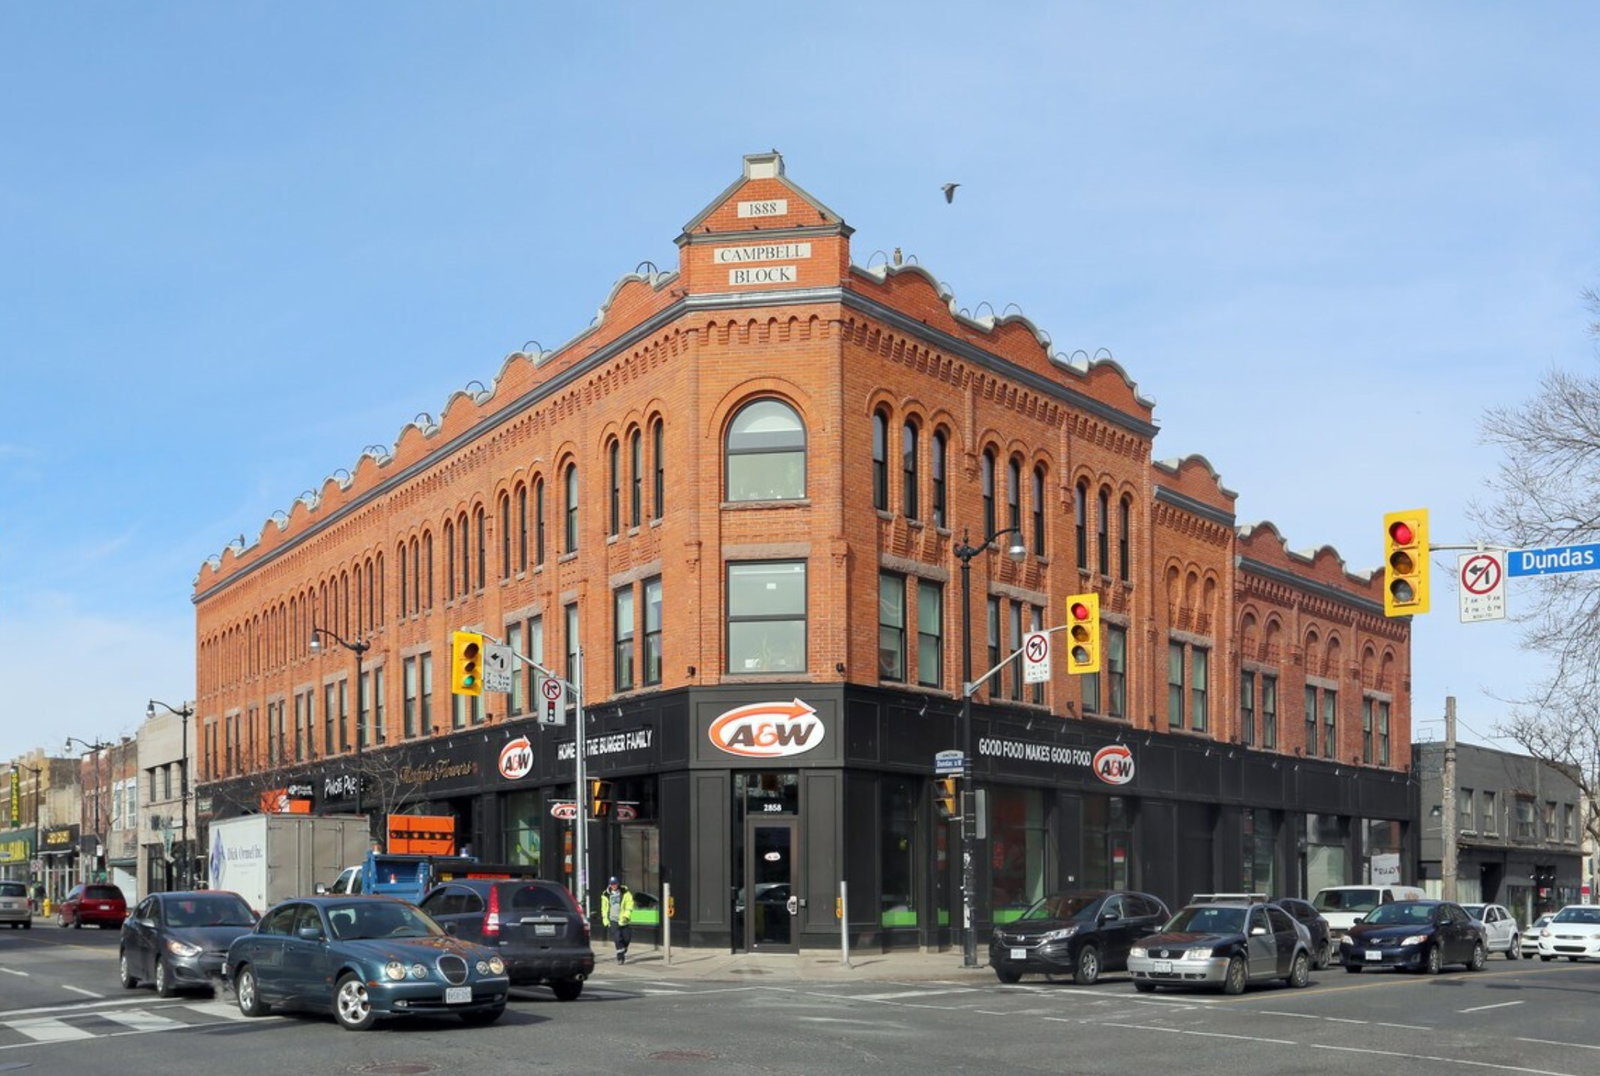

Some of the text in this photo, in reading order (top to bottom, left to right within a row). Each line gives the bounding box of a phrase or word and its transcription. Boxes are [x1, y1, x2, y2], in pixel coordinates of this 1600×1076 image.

[749, 202, 777, 216] 1888
[721, 244, 804, 262] CAMPBELL
[734, 267, 791, 284] BLOCK
[1522, 549, 1594, 571] Dundas
[557, 742, 576, 760] HOME
[586, 738, 599, 756] THE
[599, 734, 626, 754] BURGER
[626, 729, 653, 750] FAMILY
[726, 722, 817, 747] A&W
[504, 752, 531, 772] A&W
[979, 738, 1092, 767] GOOD FOOD MAKES GOOD FOOD
[1102, 760, 1132, 778] A&W
